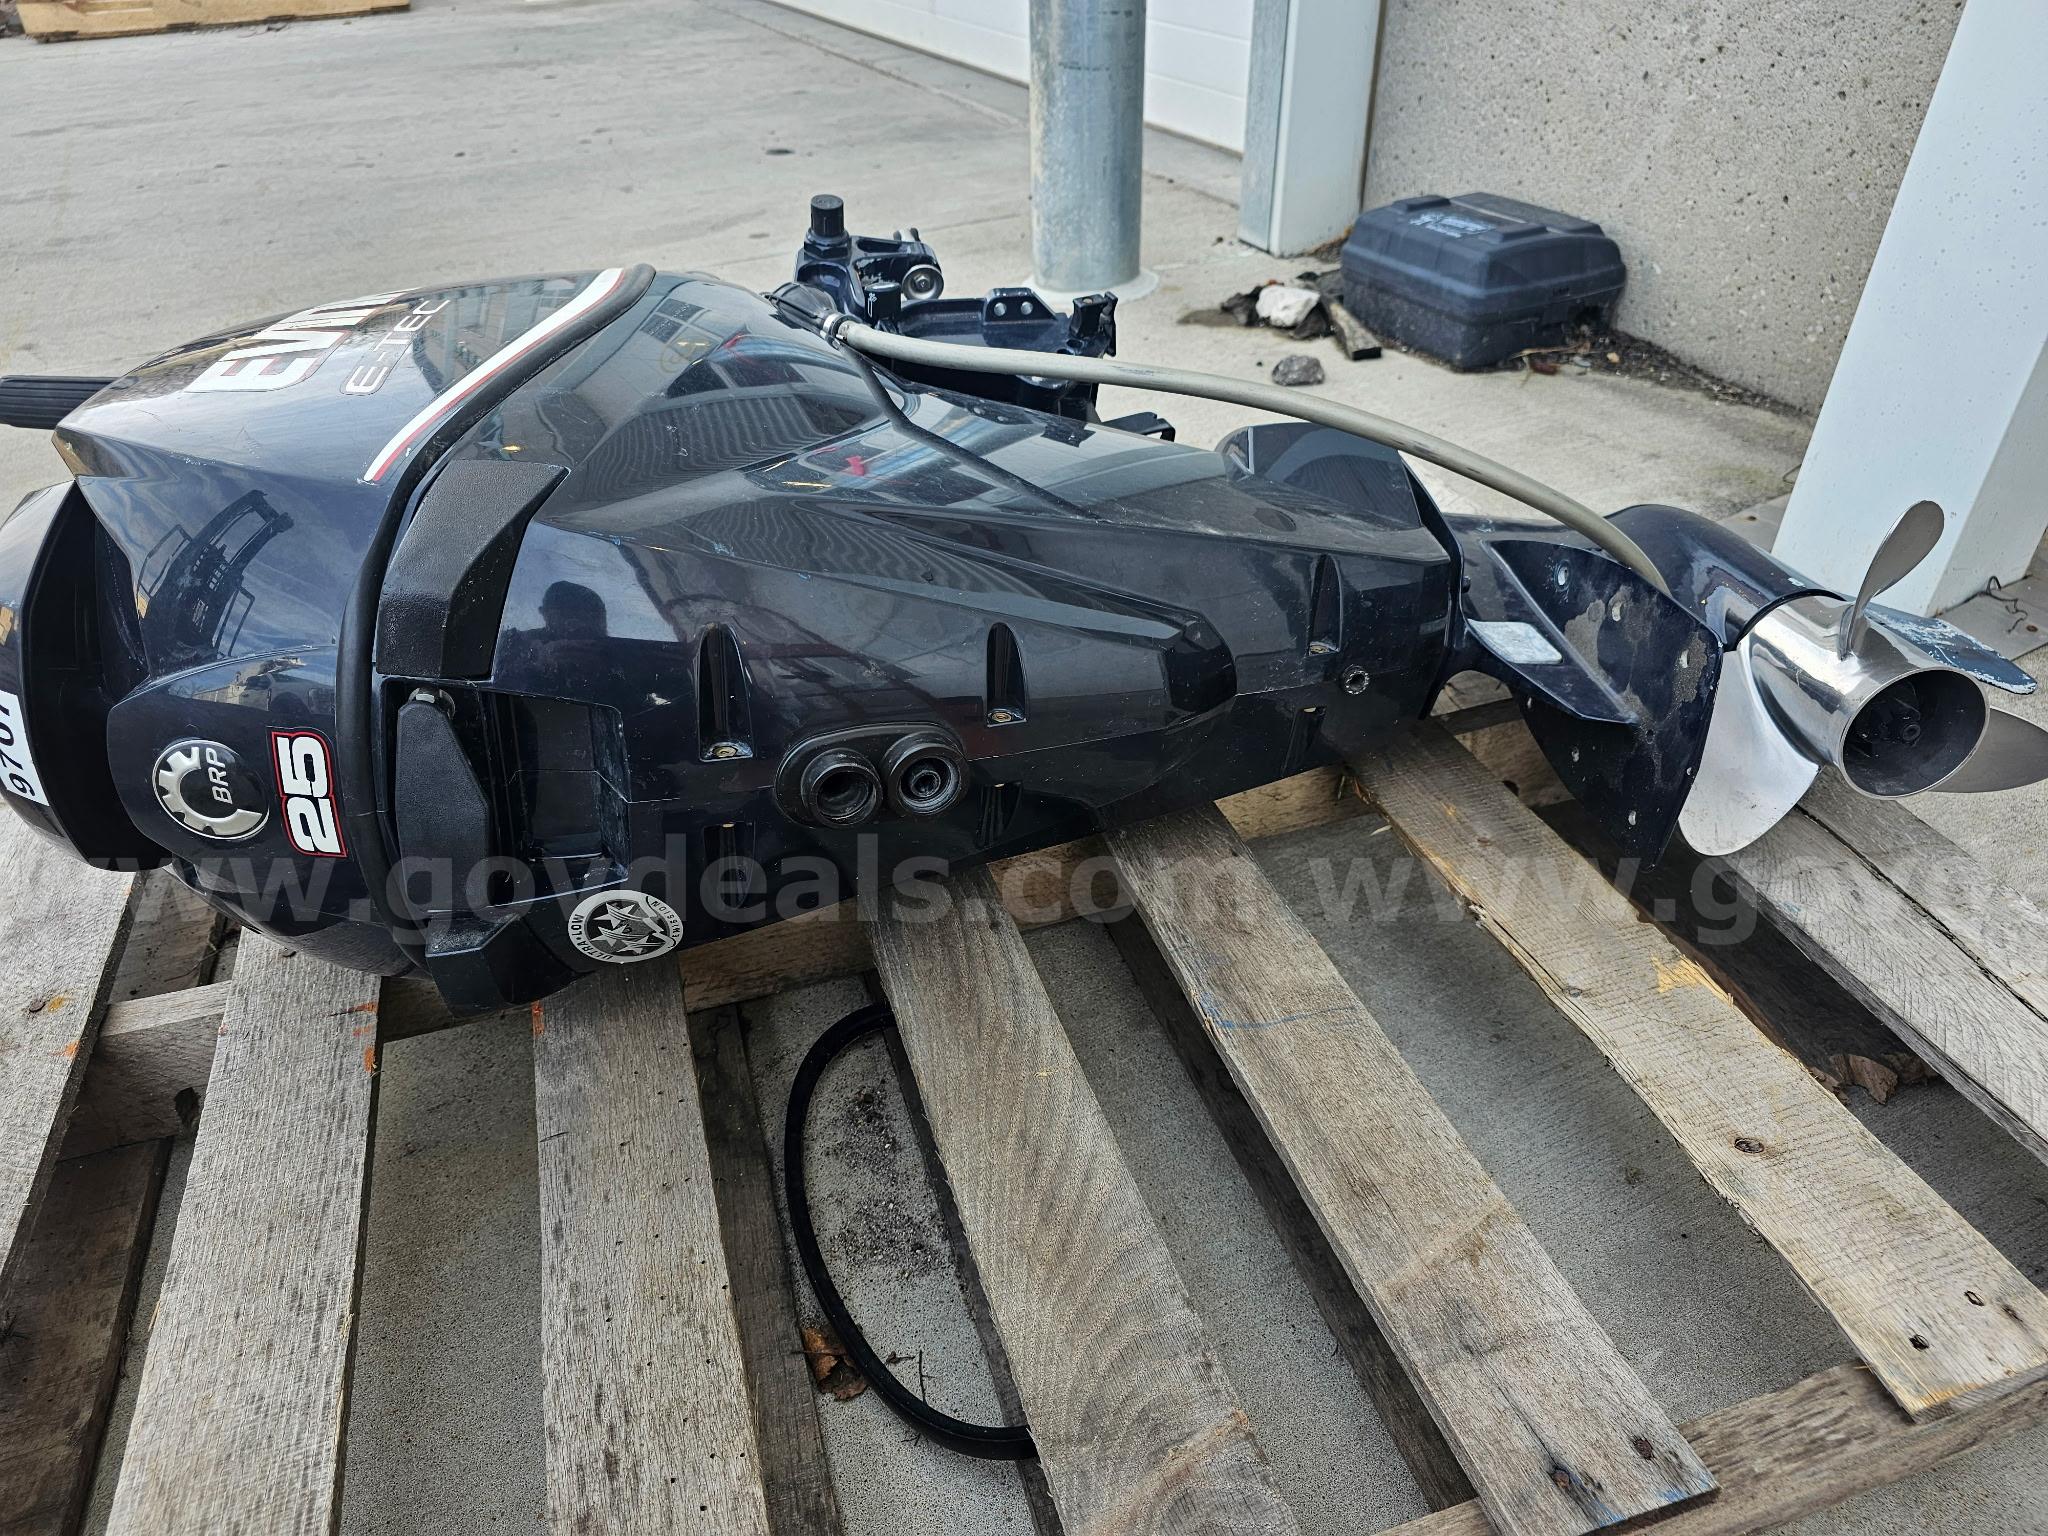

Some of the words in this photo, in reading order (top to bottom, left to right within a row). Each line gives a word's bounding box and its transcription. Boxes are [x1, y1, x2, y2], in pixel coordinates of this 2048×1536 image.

[346, 299, 450, 393] E-TEC
[206, 747, 232, 804] BRP
[273, 732, 346, 856] 25
[651, 900, 681, 938] EMISSION
